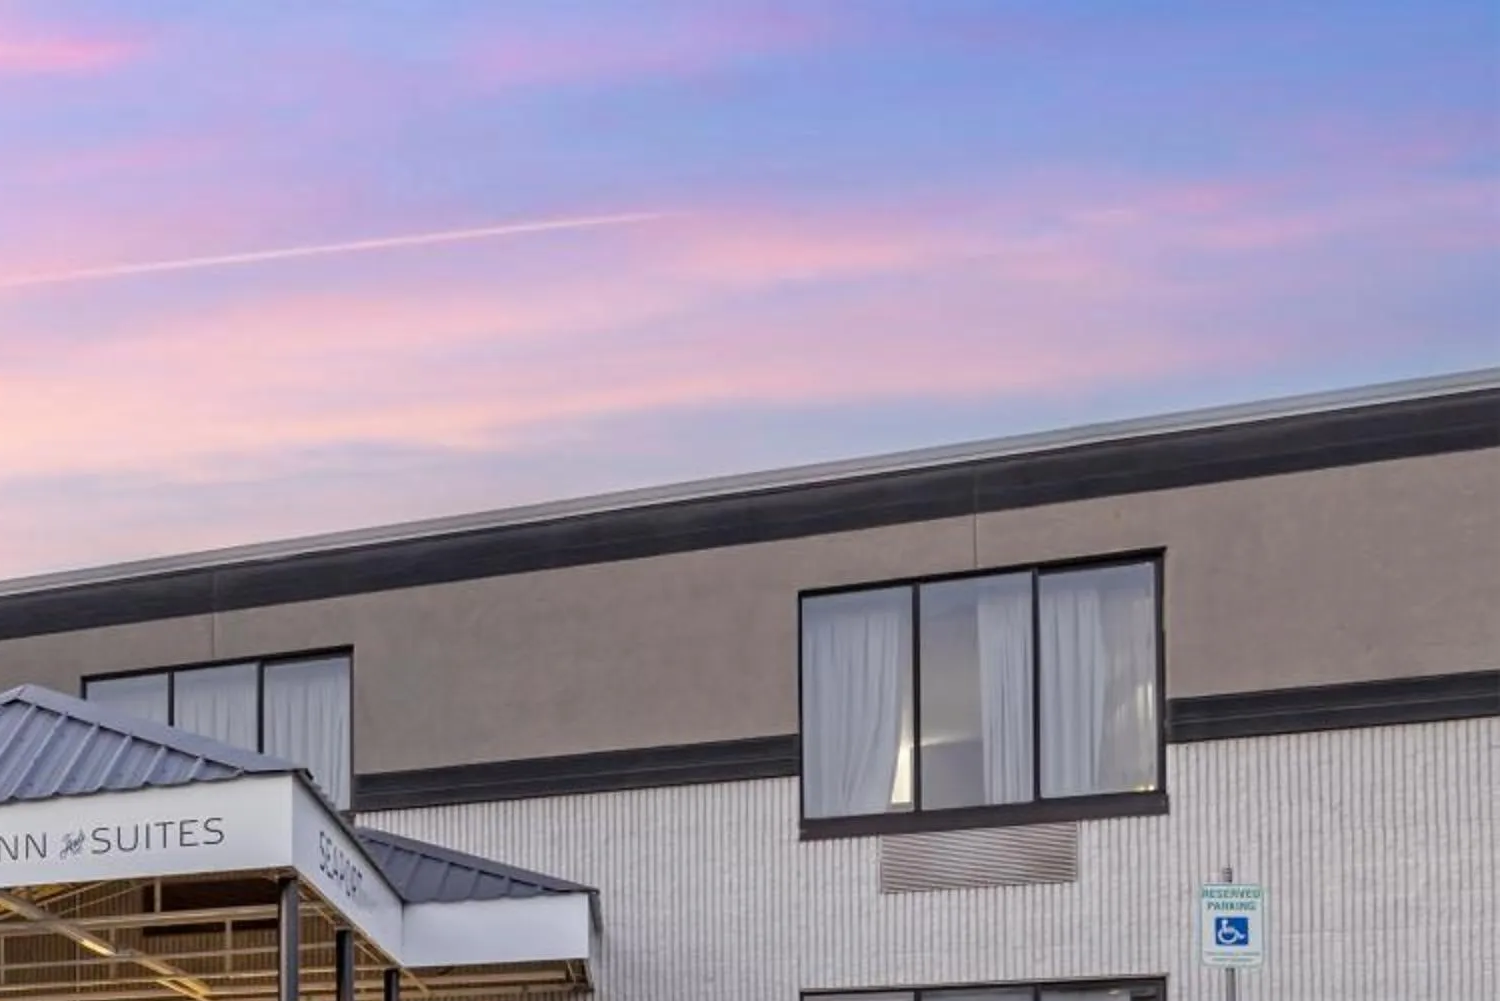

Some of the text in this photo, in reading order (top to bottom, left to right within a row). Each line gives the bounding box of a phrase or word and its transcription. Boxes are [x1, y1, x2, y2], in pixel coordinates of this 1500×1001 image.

[91, 817, 226, 856] SUITES
[1202, 888, 1261, 899] RESERVED
[1206, 901, 1257, 911] PARKING
